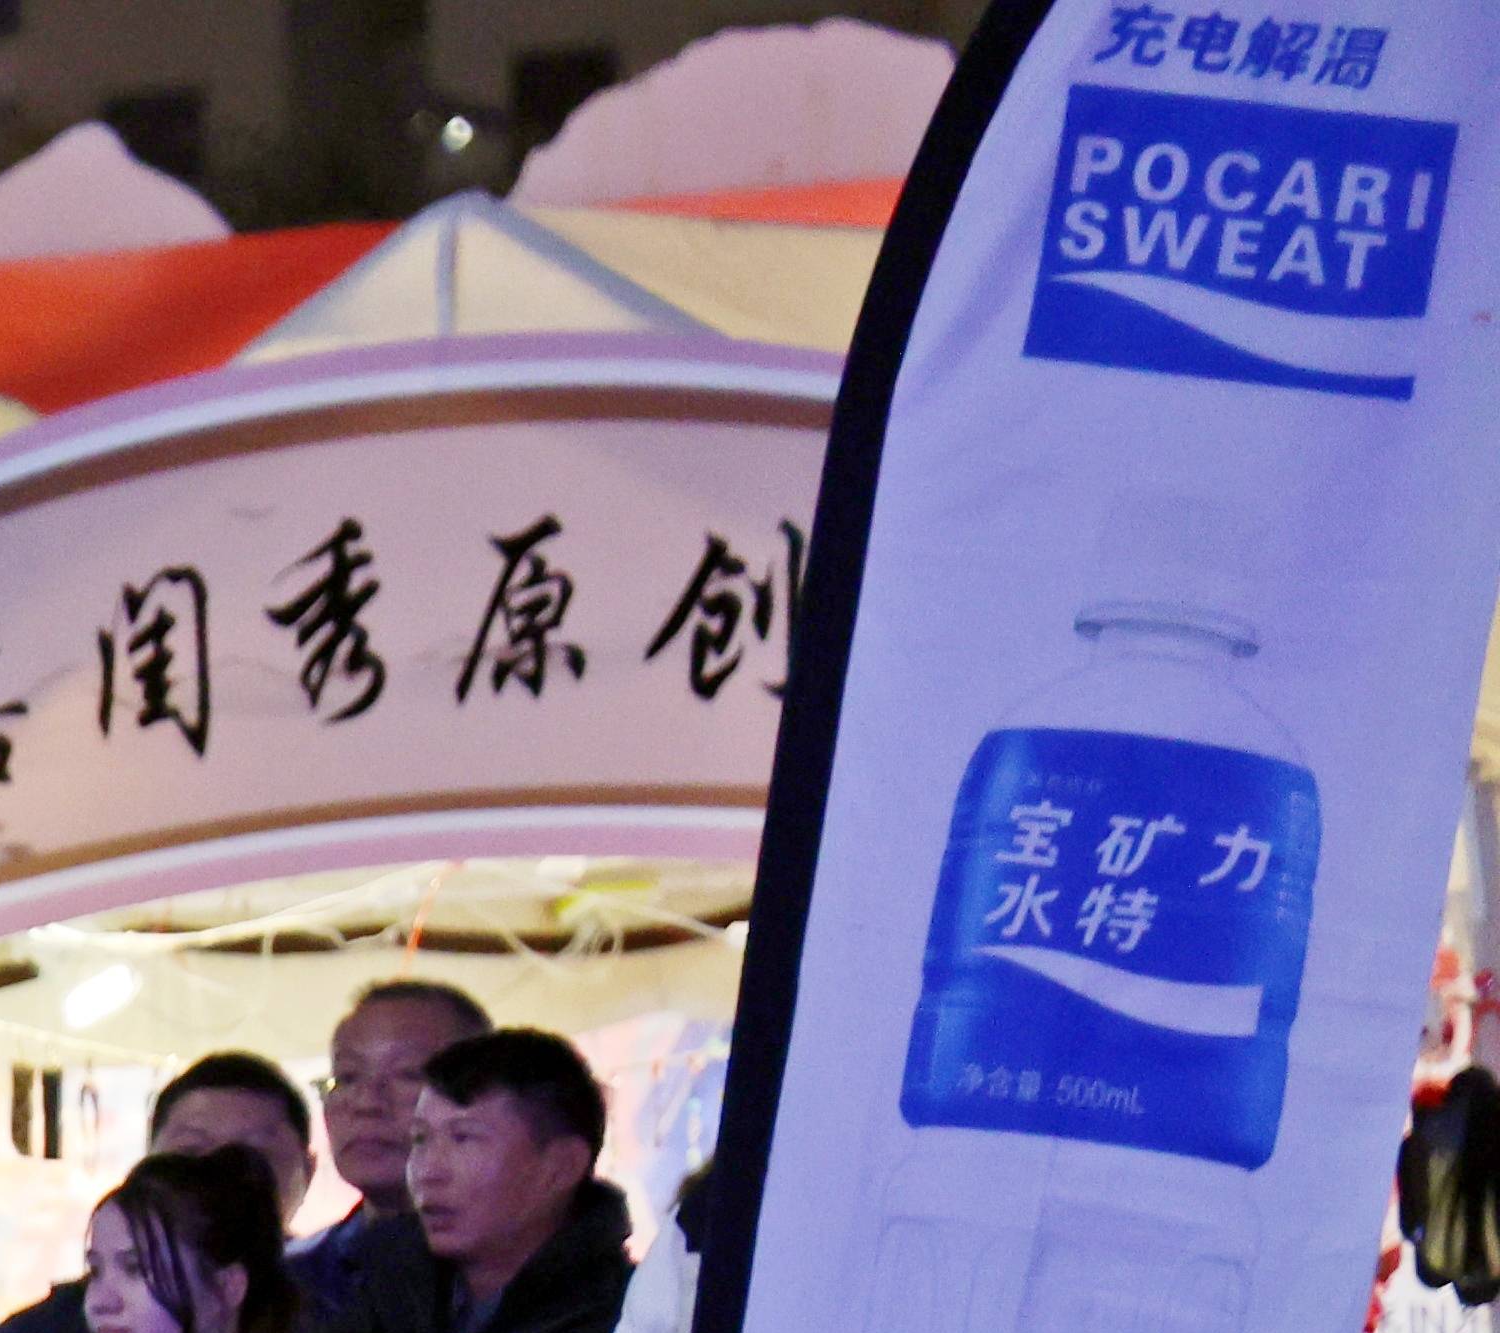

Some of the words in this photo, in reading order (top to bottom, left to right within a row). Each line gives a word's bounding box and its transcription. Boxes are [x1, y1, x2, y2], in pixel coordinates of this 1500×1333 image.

[1094, 4, 1391, 90] 充电解渴
[1071, 135, 1434, 231] POCARI
[1058, 200, 1388, 290] SWEAT
[995, 800, 1274, 893] 宝矿力
[983, 874, 1159, 954] 水特
